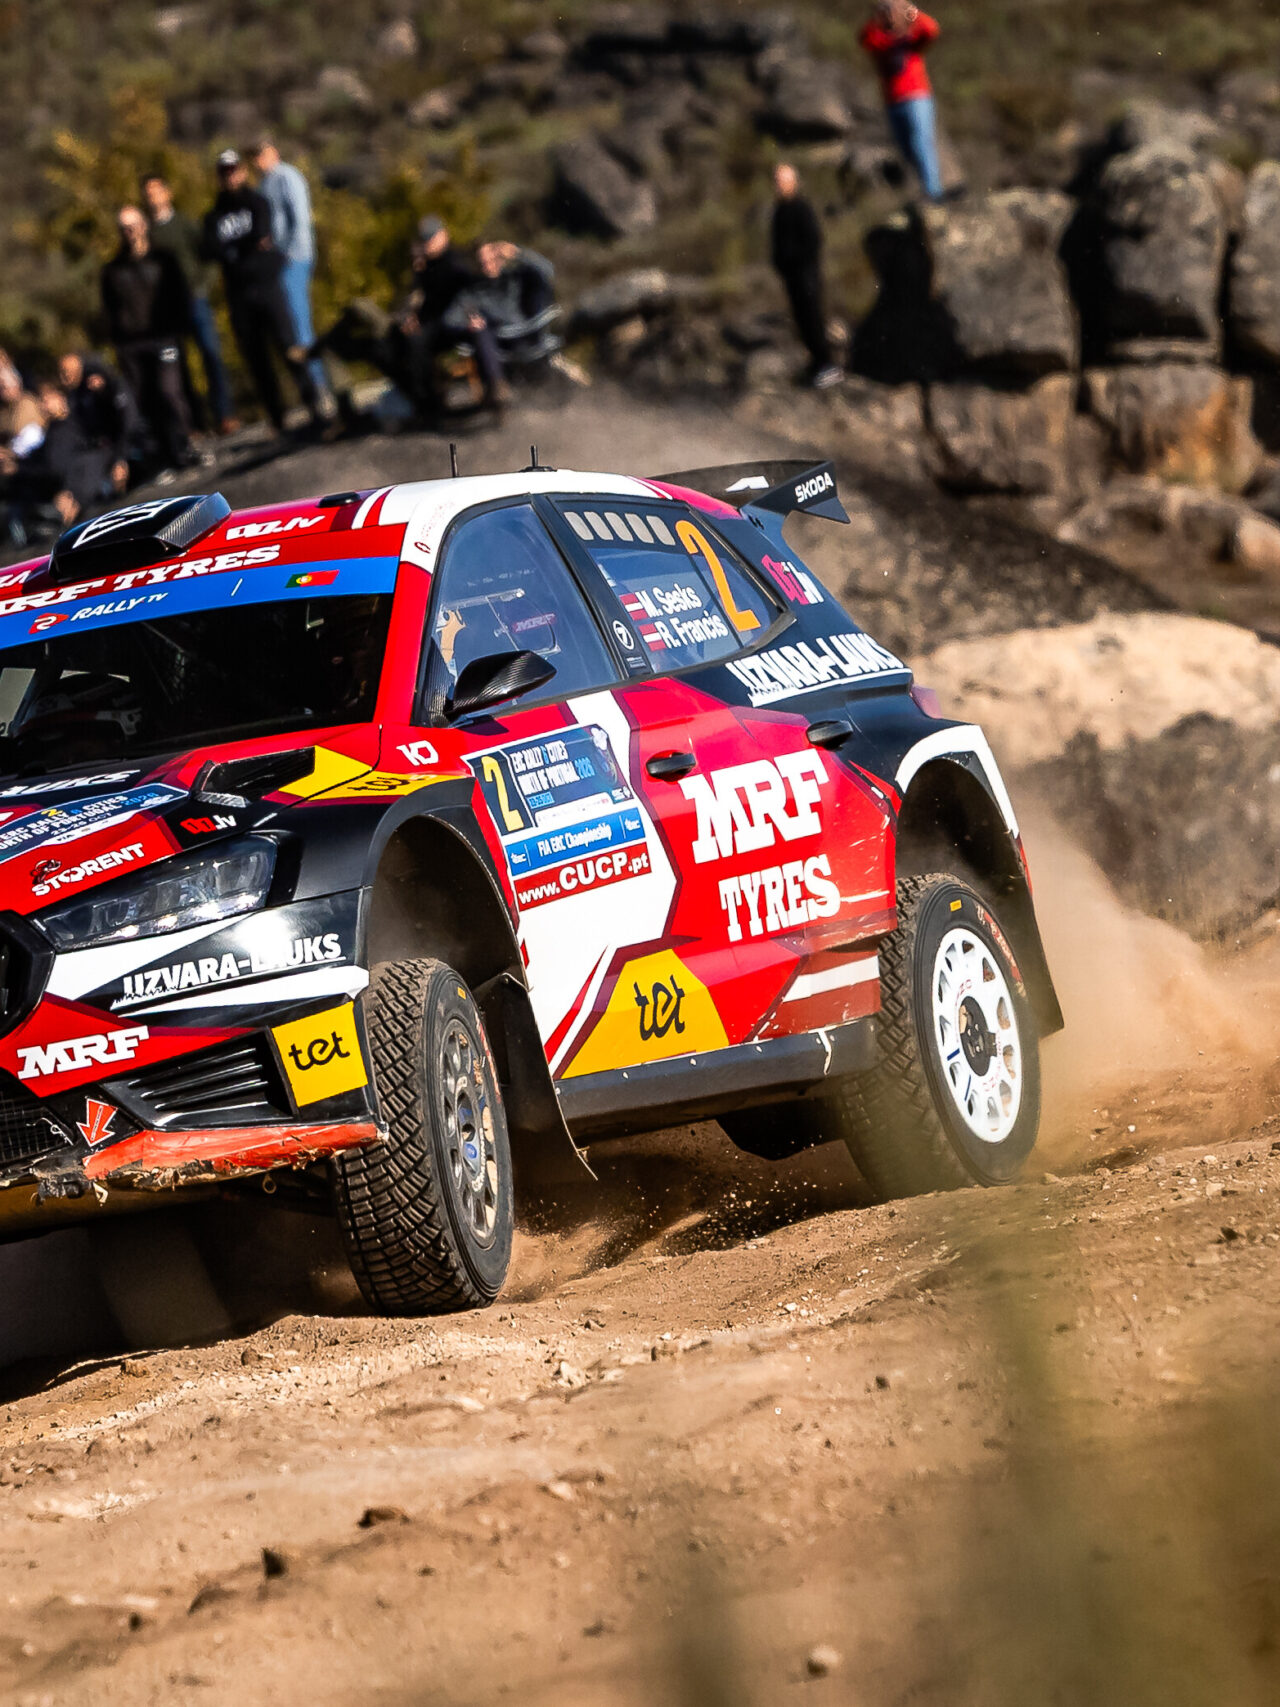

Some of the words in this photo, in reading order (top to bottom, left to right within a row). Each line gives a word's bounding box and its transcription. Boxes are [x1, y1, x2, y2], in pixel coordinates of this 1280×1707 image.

[795, 472, 834, 503] SKODA
[113, 545, 281, 591] TYRES
[675, 520, 760, 632] 2
[71, 596, 147, 621] RALLY
[147, 592, 168, 601] TV
[634, 590, 663, 618] M.
[652, 583, 702, 615] Sesks
[654, 620, 681, 649] R.
[670, 610, 729, 645] Francis
[725, 633, 904, 694] UZVARA-LAUKS
[0, 827, 29, 840] ERC
[26, 812, 70, 829] RALLY
[82, 795, 128, 810] CITIES
[31, 824, 50, 836] OF
[50, 804, 122, 829] PORTUGAL
[41, 808, 63, 818] 2
[481, 755, 524, 832] 2
[678, 748, 829, 864] MRF
[31, 843, 144, 896] STORENT
[518, 851, 650, 905] www.CUCP.pt
[718, 854, 841, 942] TYRES
[122, 933, 342, 997] UZVARA-LUKS
[634, 973, 687, 1041] tet
[17, 1025, 150, 1080] MRF
[289, 1031, 351, 1071] tet
